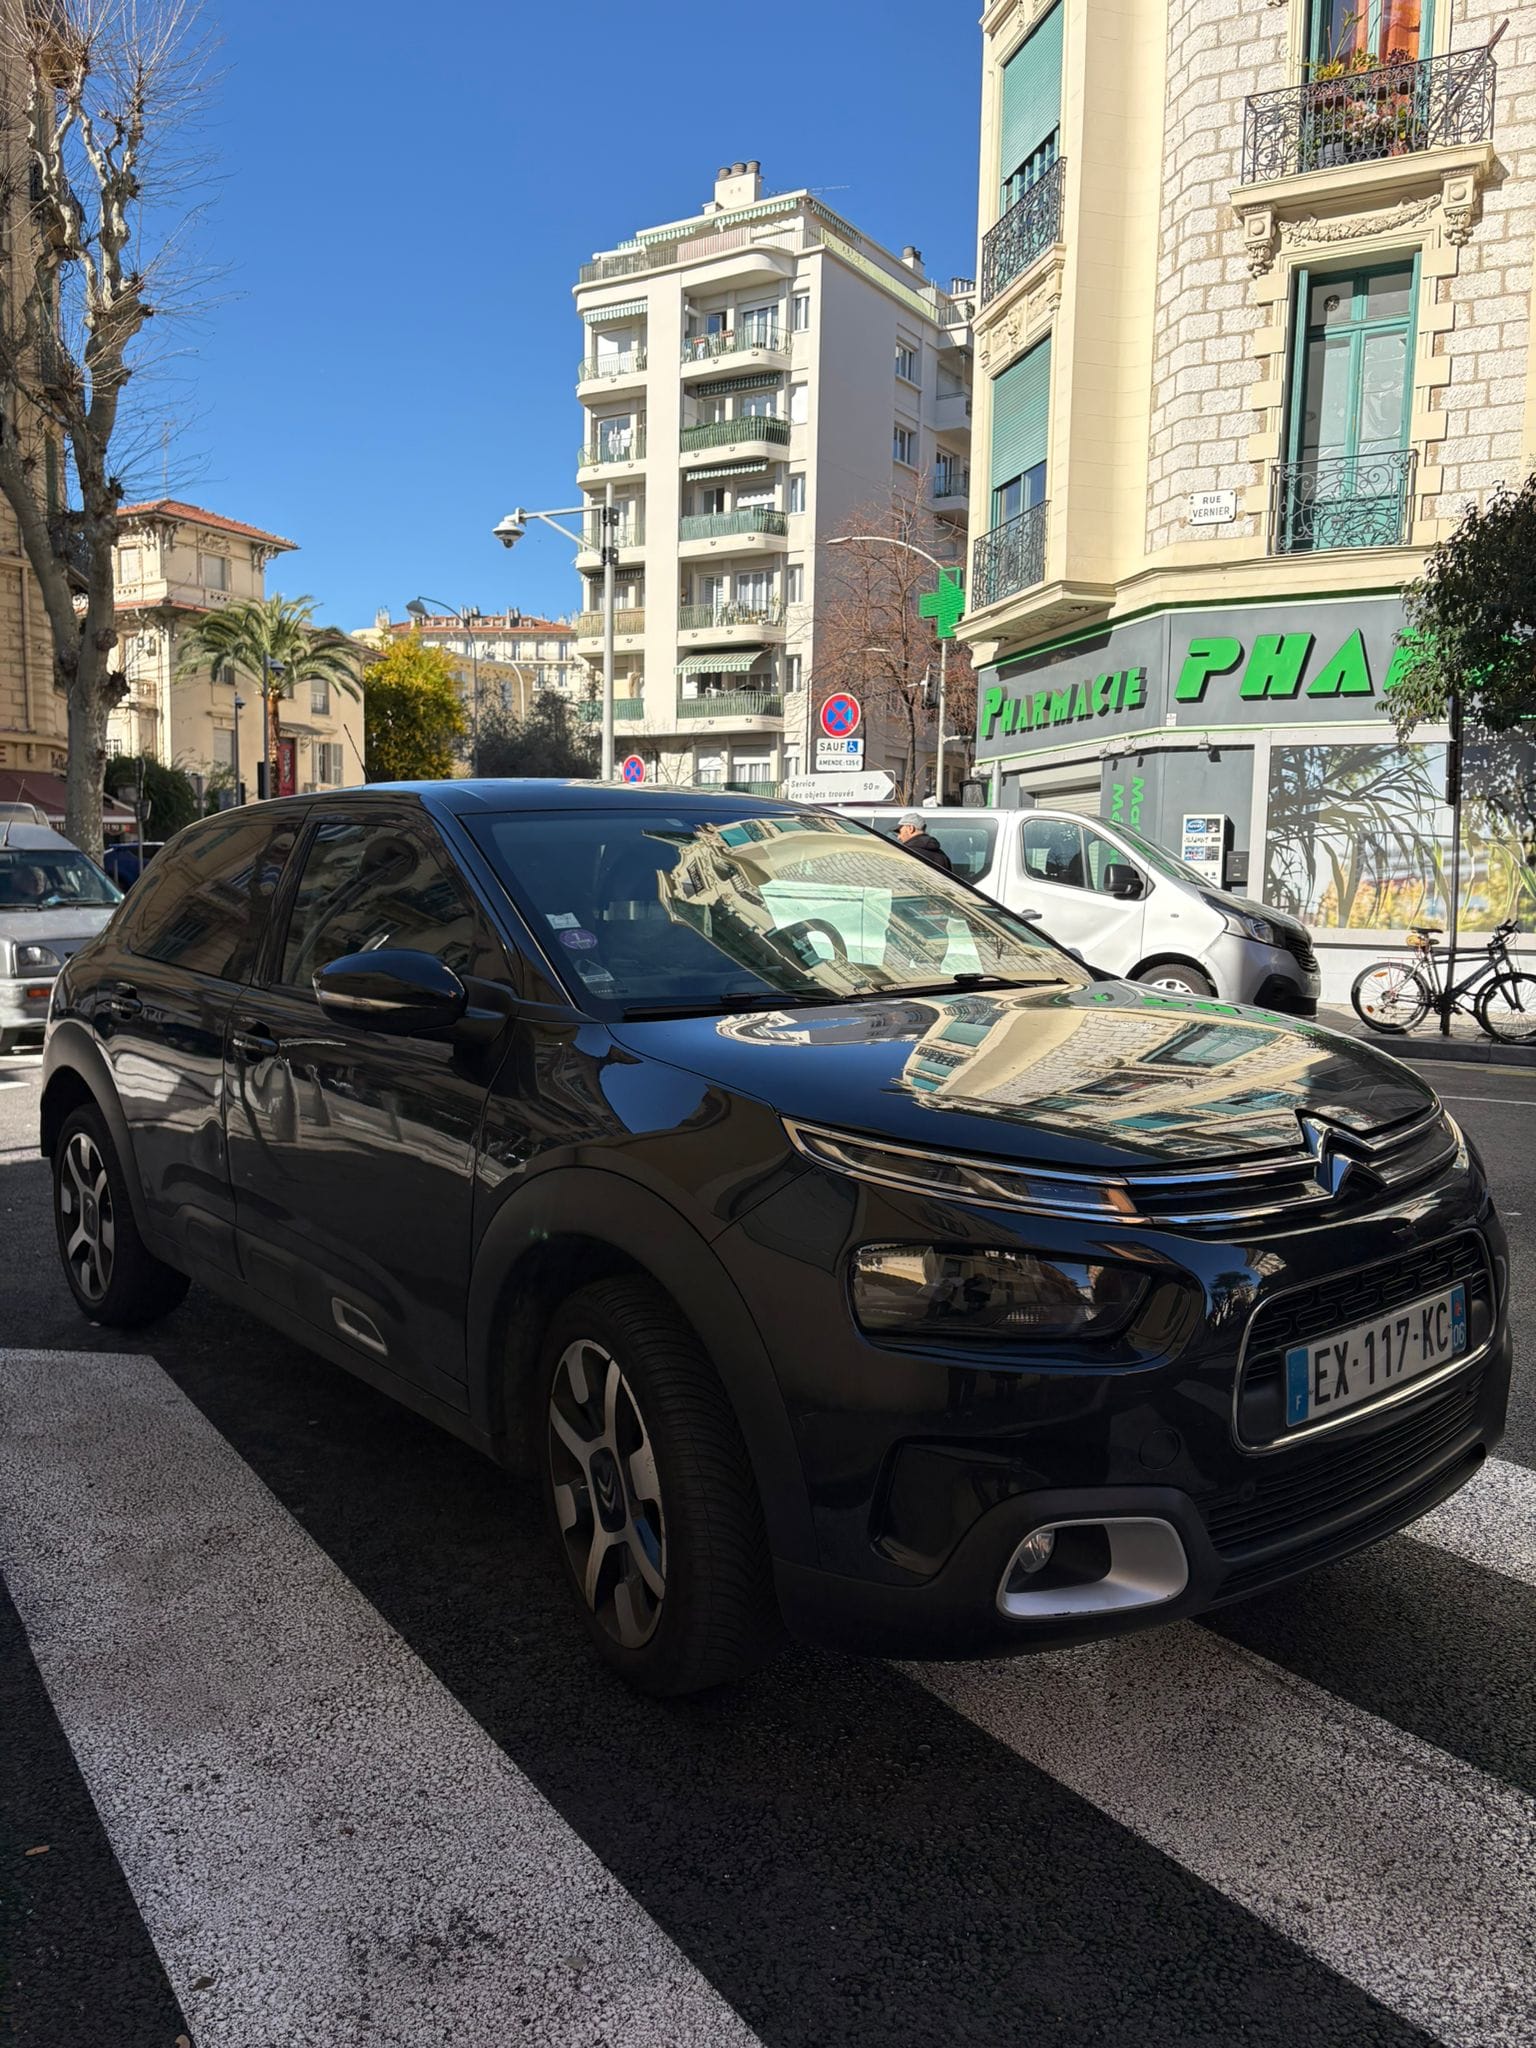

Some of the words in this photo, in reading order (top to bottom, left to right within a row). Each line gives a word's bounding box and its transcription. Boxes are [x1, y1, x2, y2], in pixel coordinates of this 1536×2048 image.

[1202, 495, 1222, 505] RUE
[1192, 506, 1230, 518] VERNIER
[980, 667, 1143, 738] PHARMACIE
[820, 742, 846, 751] SAUF
[791, 780, 816, 788] Service
[863, 782, 874, 791] 50
[804, 791, 826, 801] objets
[828, 790, 855, 798] trouvés
[1453, 1321, 1465, 1347] 06
[1314, 1302, 1448, 1406] EX-117-KC
[1295, 1394, 1302, 1411] F
